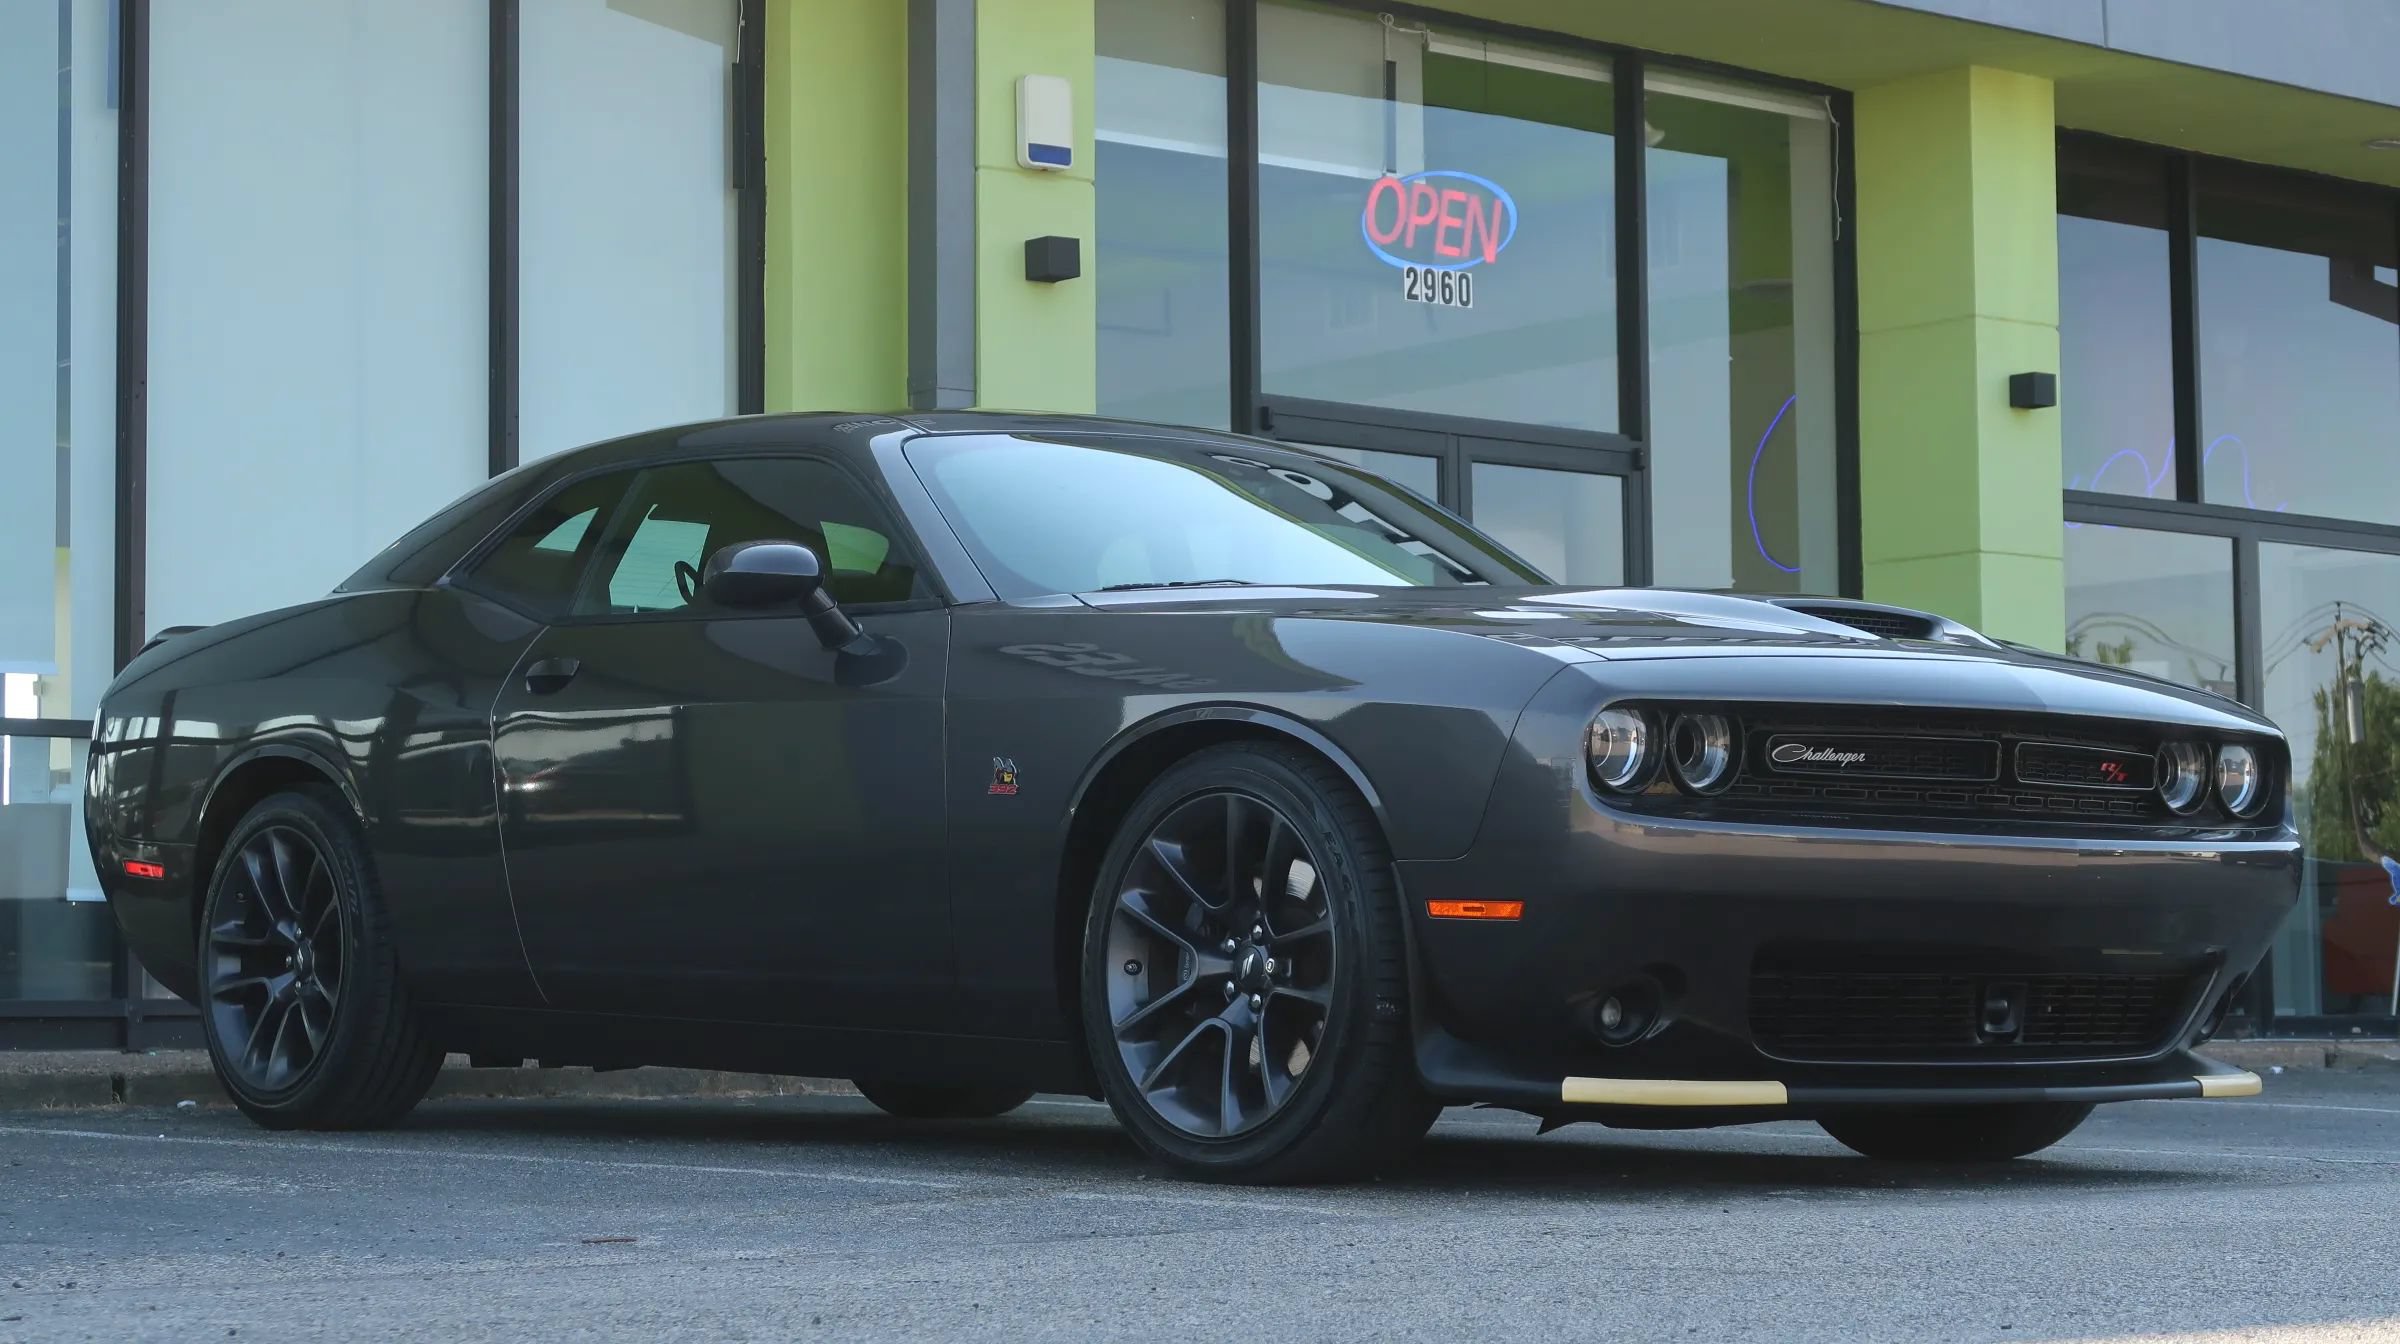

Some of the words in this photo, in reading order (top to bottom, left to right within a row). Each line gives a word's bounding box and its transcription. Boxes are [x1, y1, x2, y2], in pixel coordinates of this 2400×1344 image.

[1366, 176, 1502, 264] OPEN
[1405, 266, 1471, 307] 2960
[1772, 743, 1866, 767] Challenger
